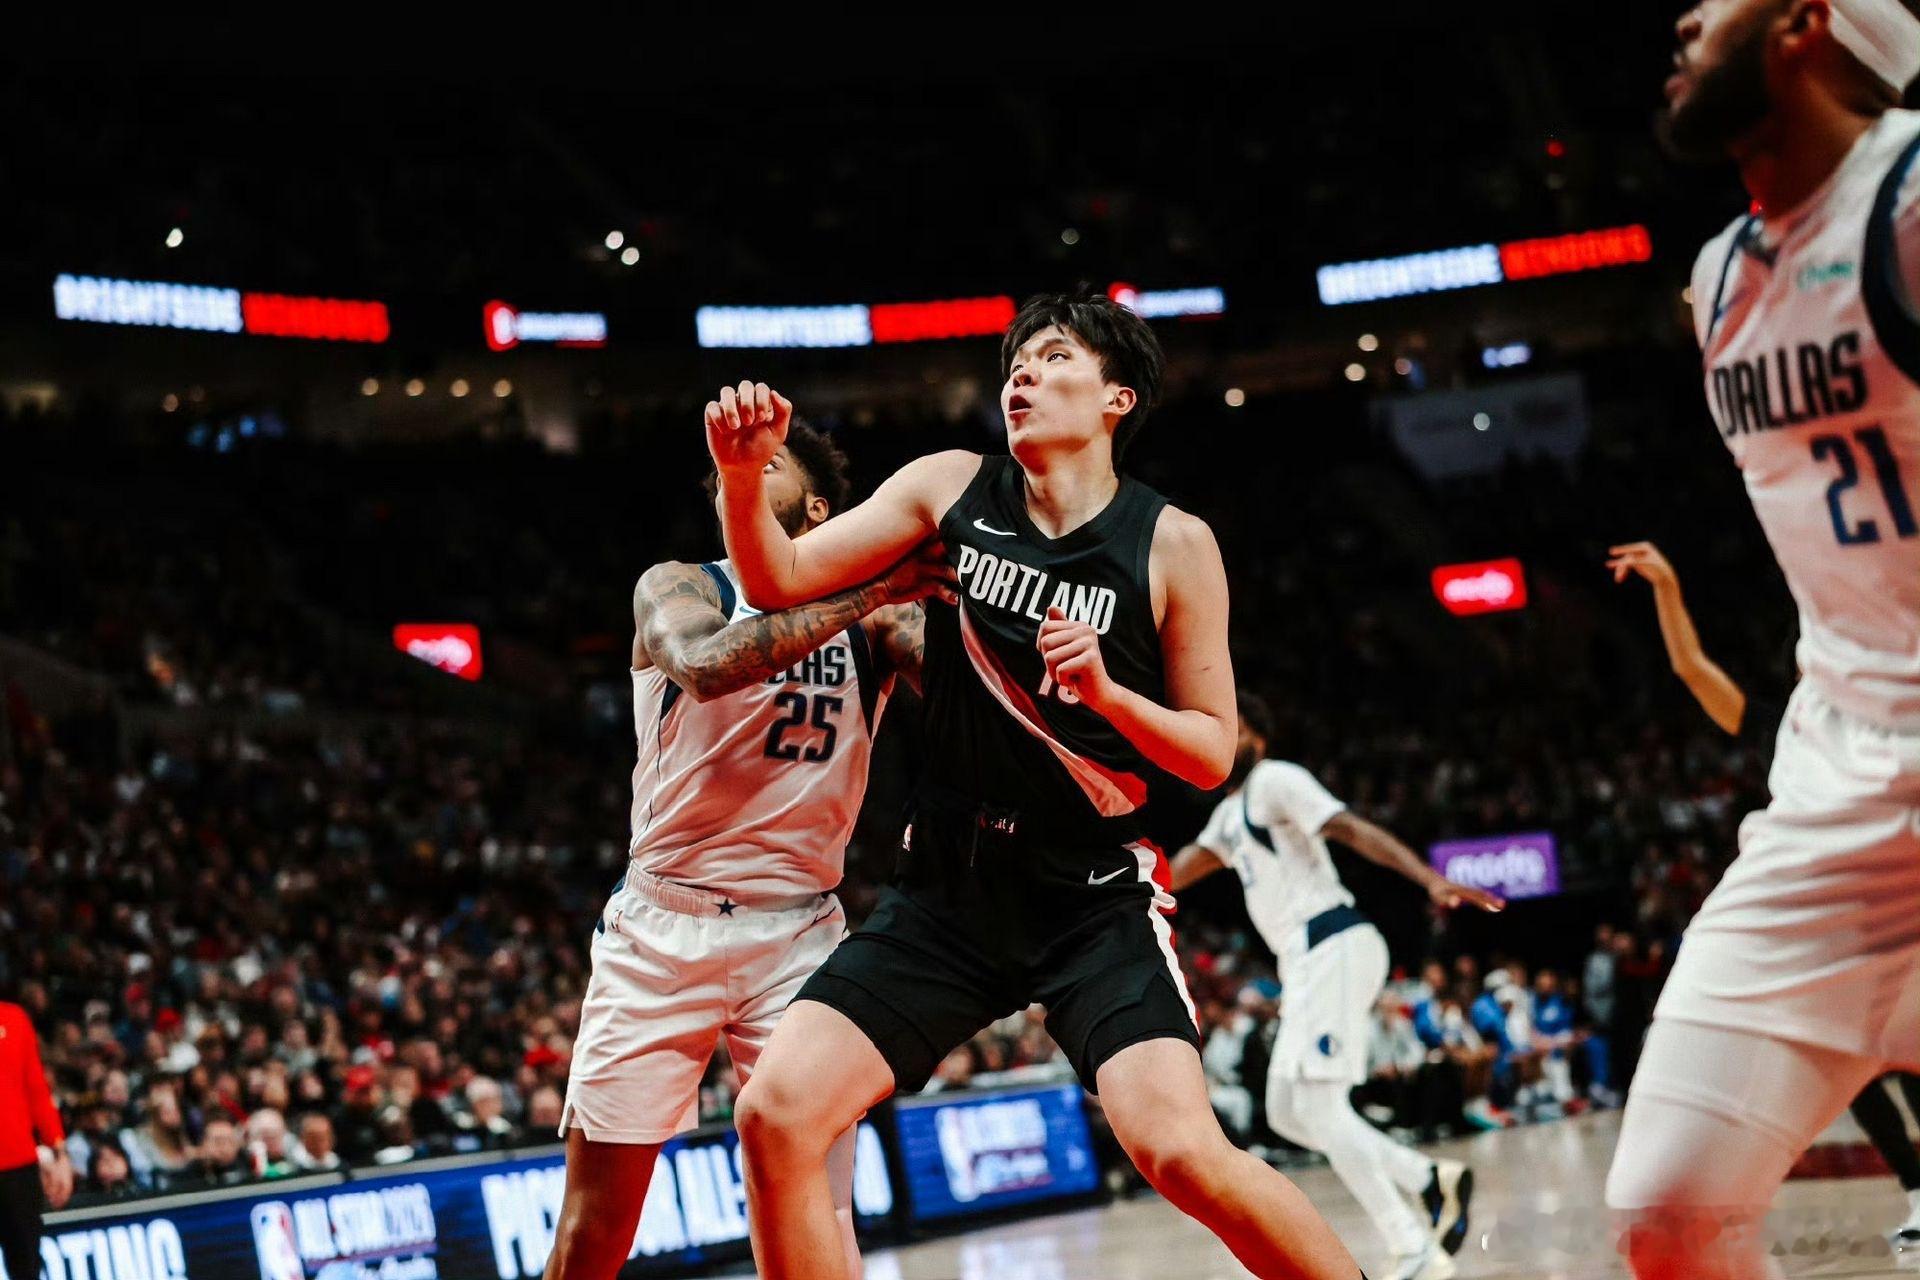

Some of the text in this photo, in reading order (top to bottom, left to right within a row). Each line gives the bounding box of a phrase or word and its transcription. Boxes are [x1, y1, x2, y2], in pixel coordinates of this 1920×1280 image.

[1713, 331, 1868, 438] DALLAS
[1809, 423, 1919, 546] 21
[957, 544, 1117, 635] PORTLAND
[767, 645, 846, 686] LAS
[764, 690, 844, 762] 25
